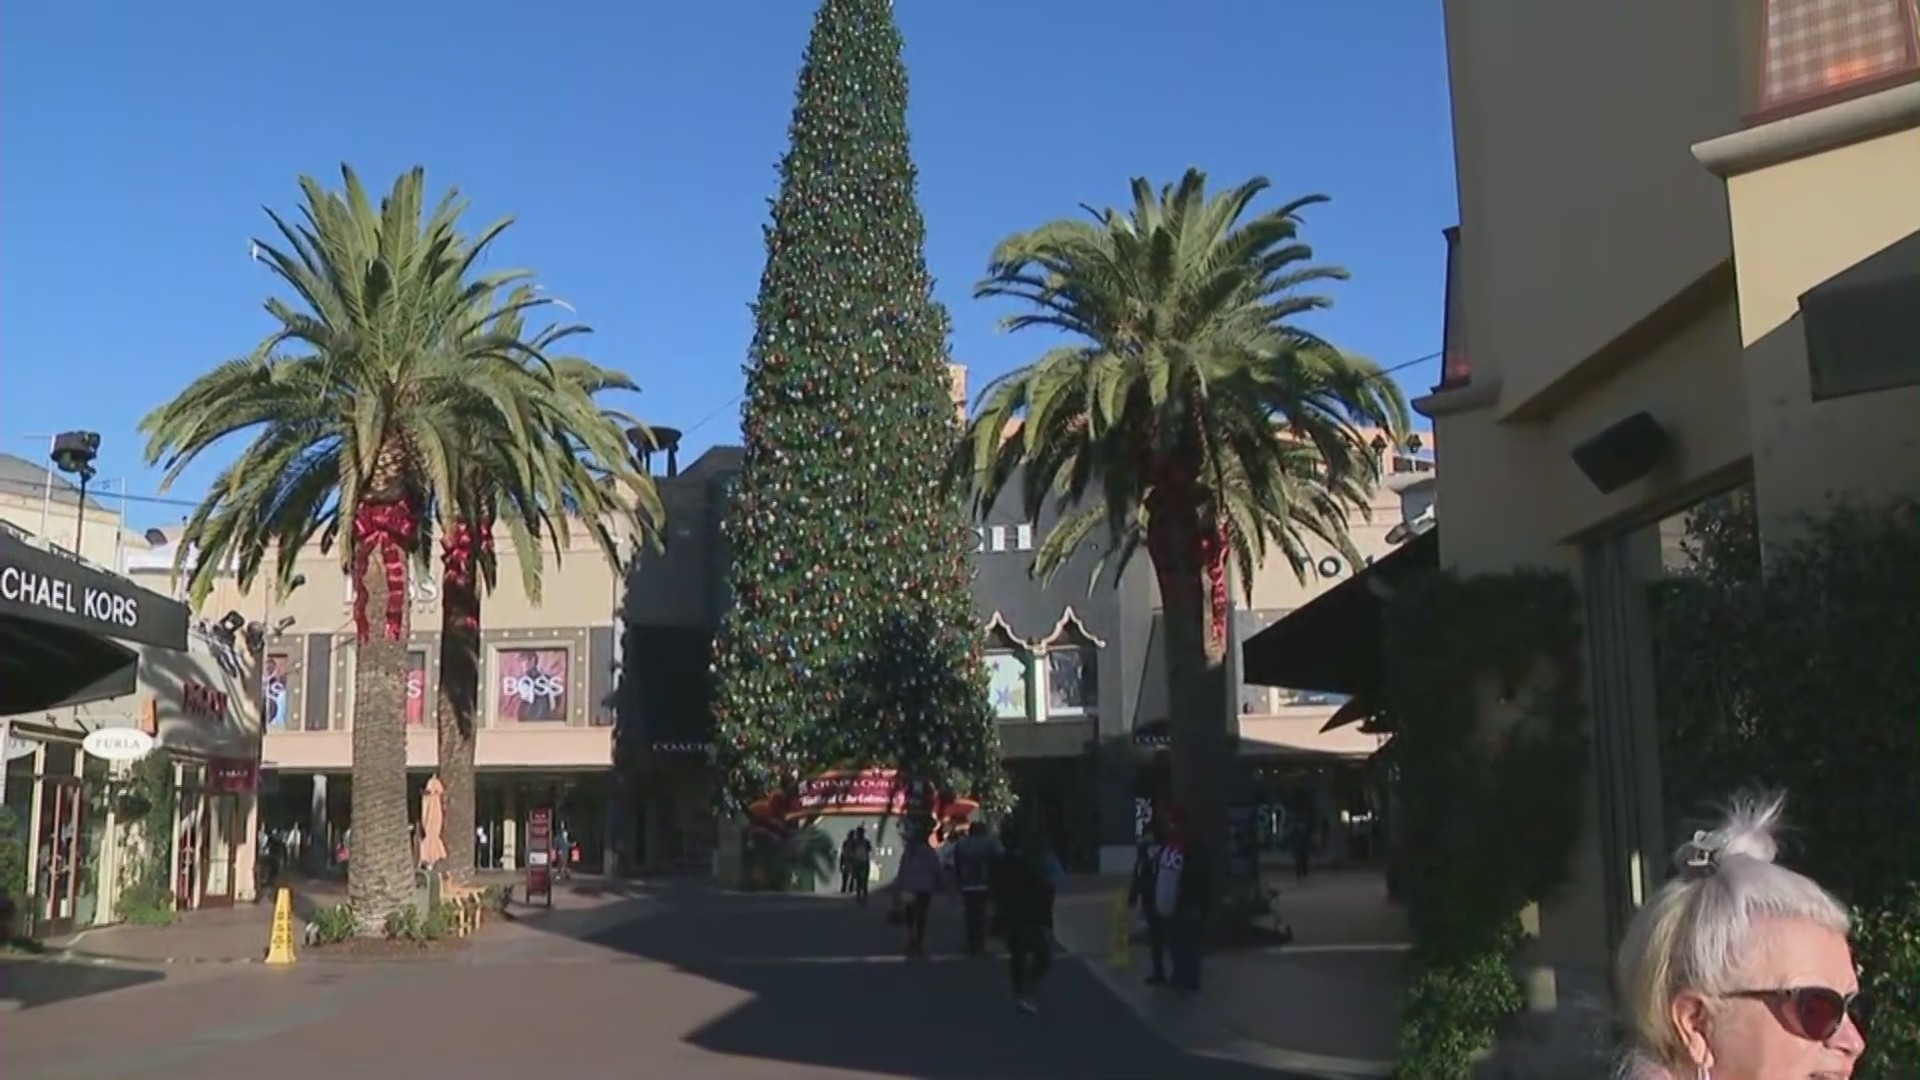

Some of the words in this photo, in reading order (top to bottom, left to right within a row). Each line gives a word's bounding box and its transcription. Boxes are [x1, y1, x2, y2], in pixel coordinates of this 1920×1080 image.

[83, 587, 138, 628] KORS
[503, 675, 564, 696] BOSS
[95, 738, 141, 750] FURLA
